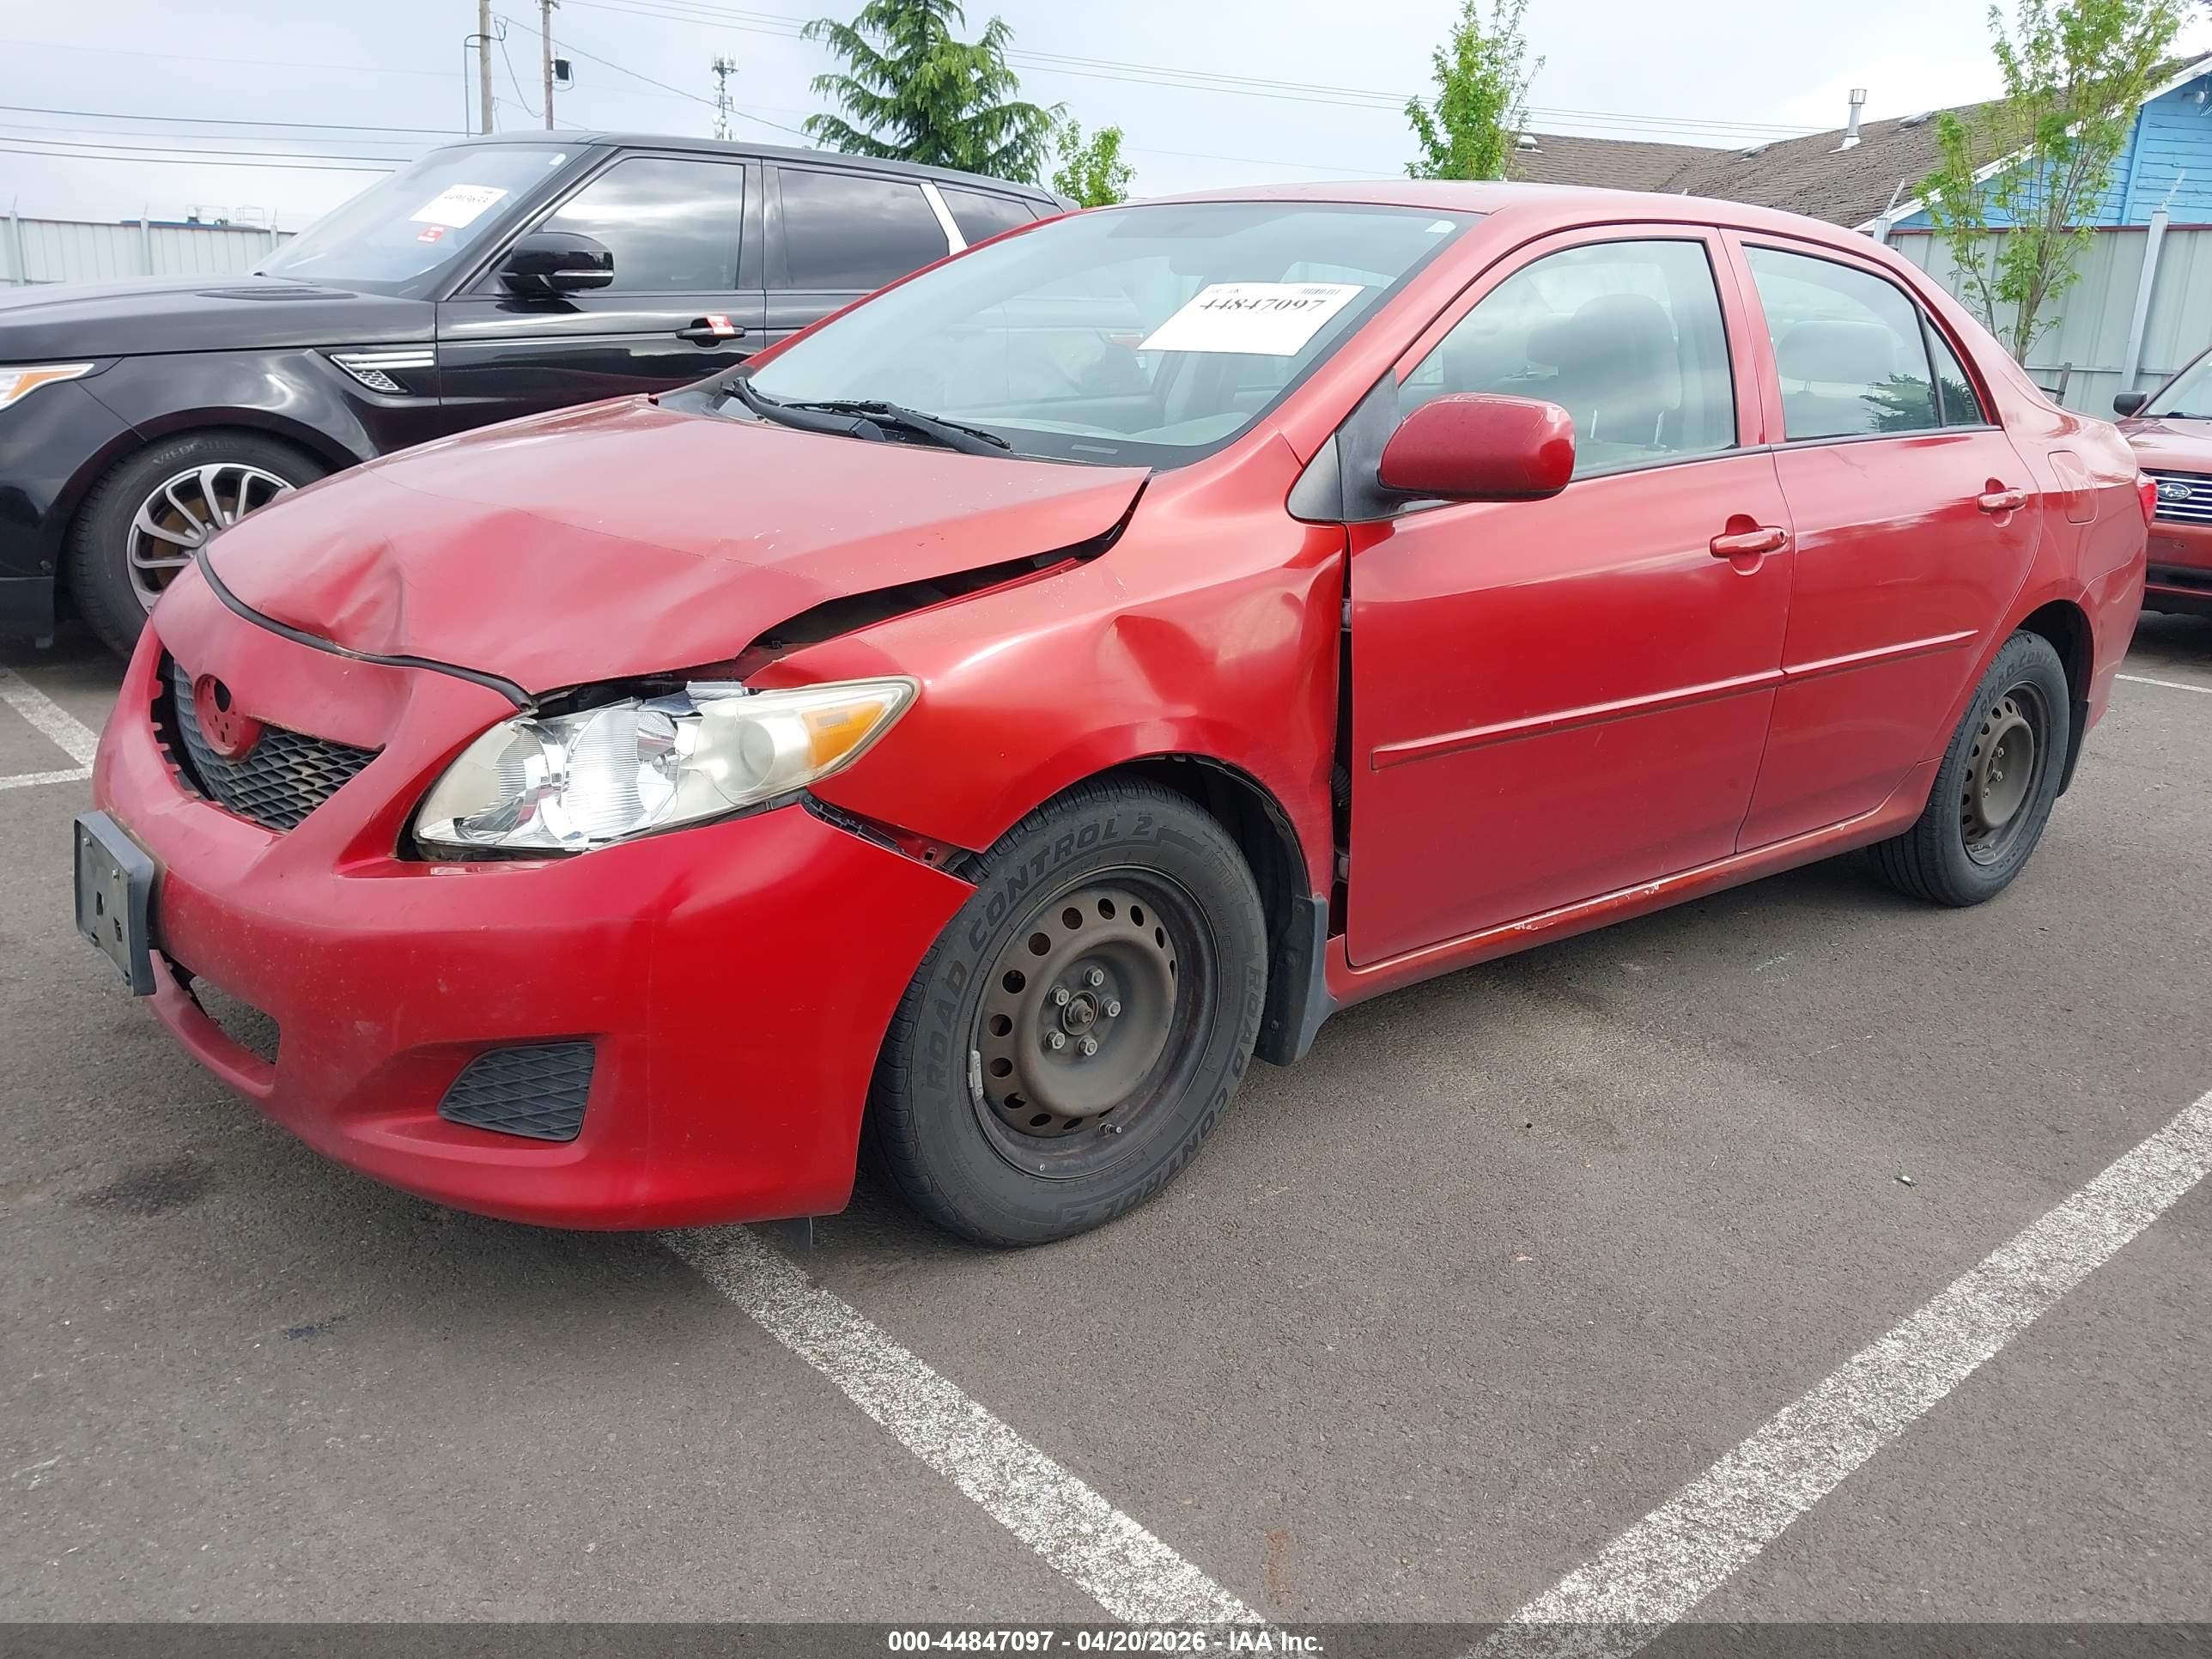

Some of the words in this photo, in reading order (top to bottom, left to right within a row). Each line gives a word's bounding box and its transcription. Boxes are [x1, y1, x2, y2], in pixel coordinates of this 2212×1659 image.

[1200, 298, 1327, 312] 44847097
[927, 960, 967, 1092] ROAD
[969, 817, 1118, 952] CONTROL
[1132, 816, 1153, 836] 2
